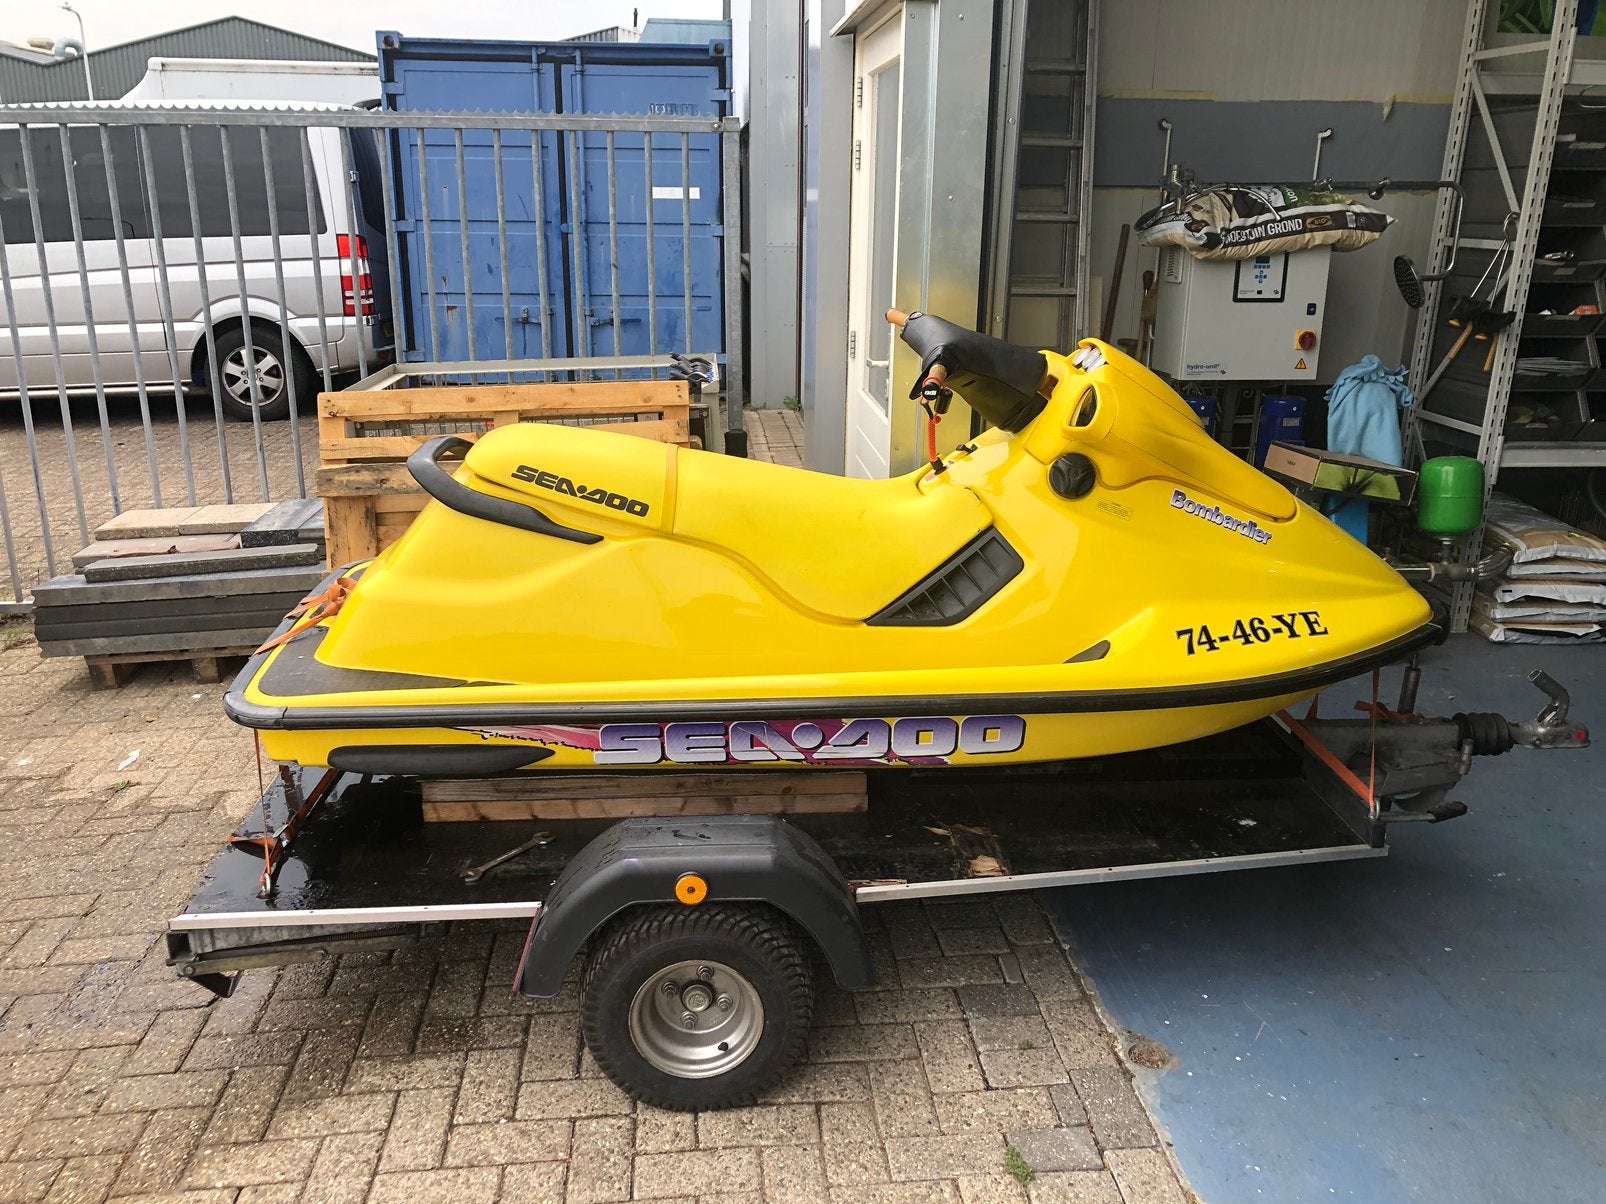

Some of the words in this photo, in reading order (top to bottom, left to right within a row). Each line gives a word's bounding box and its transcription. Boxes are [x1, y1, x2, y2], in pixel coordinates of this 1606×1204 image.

[1267, 218, 1303, 235] GROND
[1170, 488, 1273, 545] Bombardier
[1175, 611, 1329, 656] 74-46-YE
